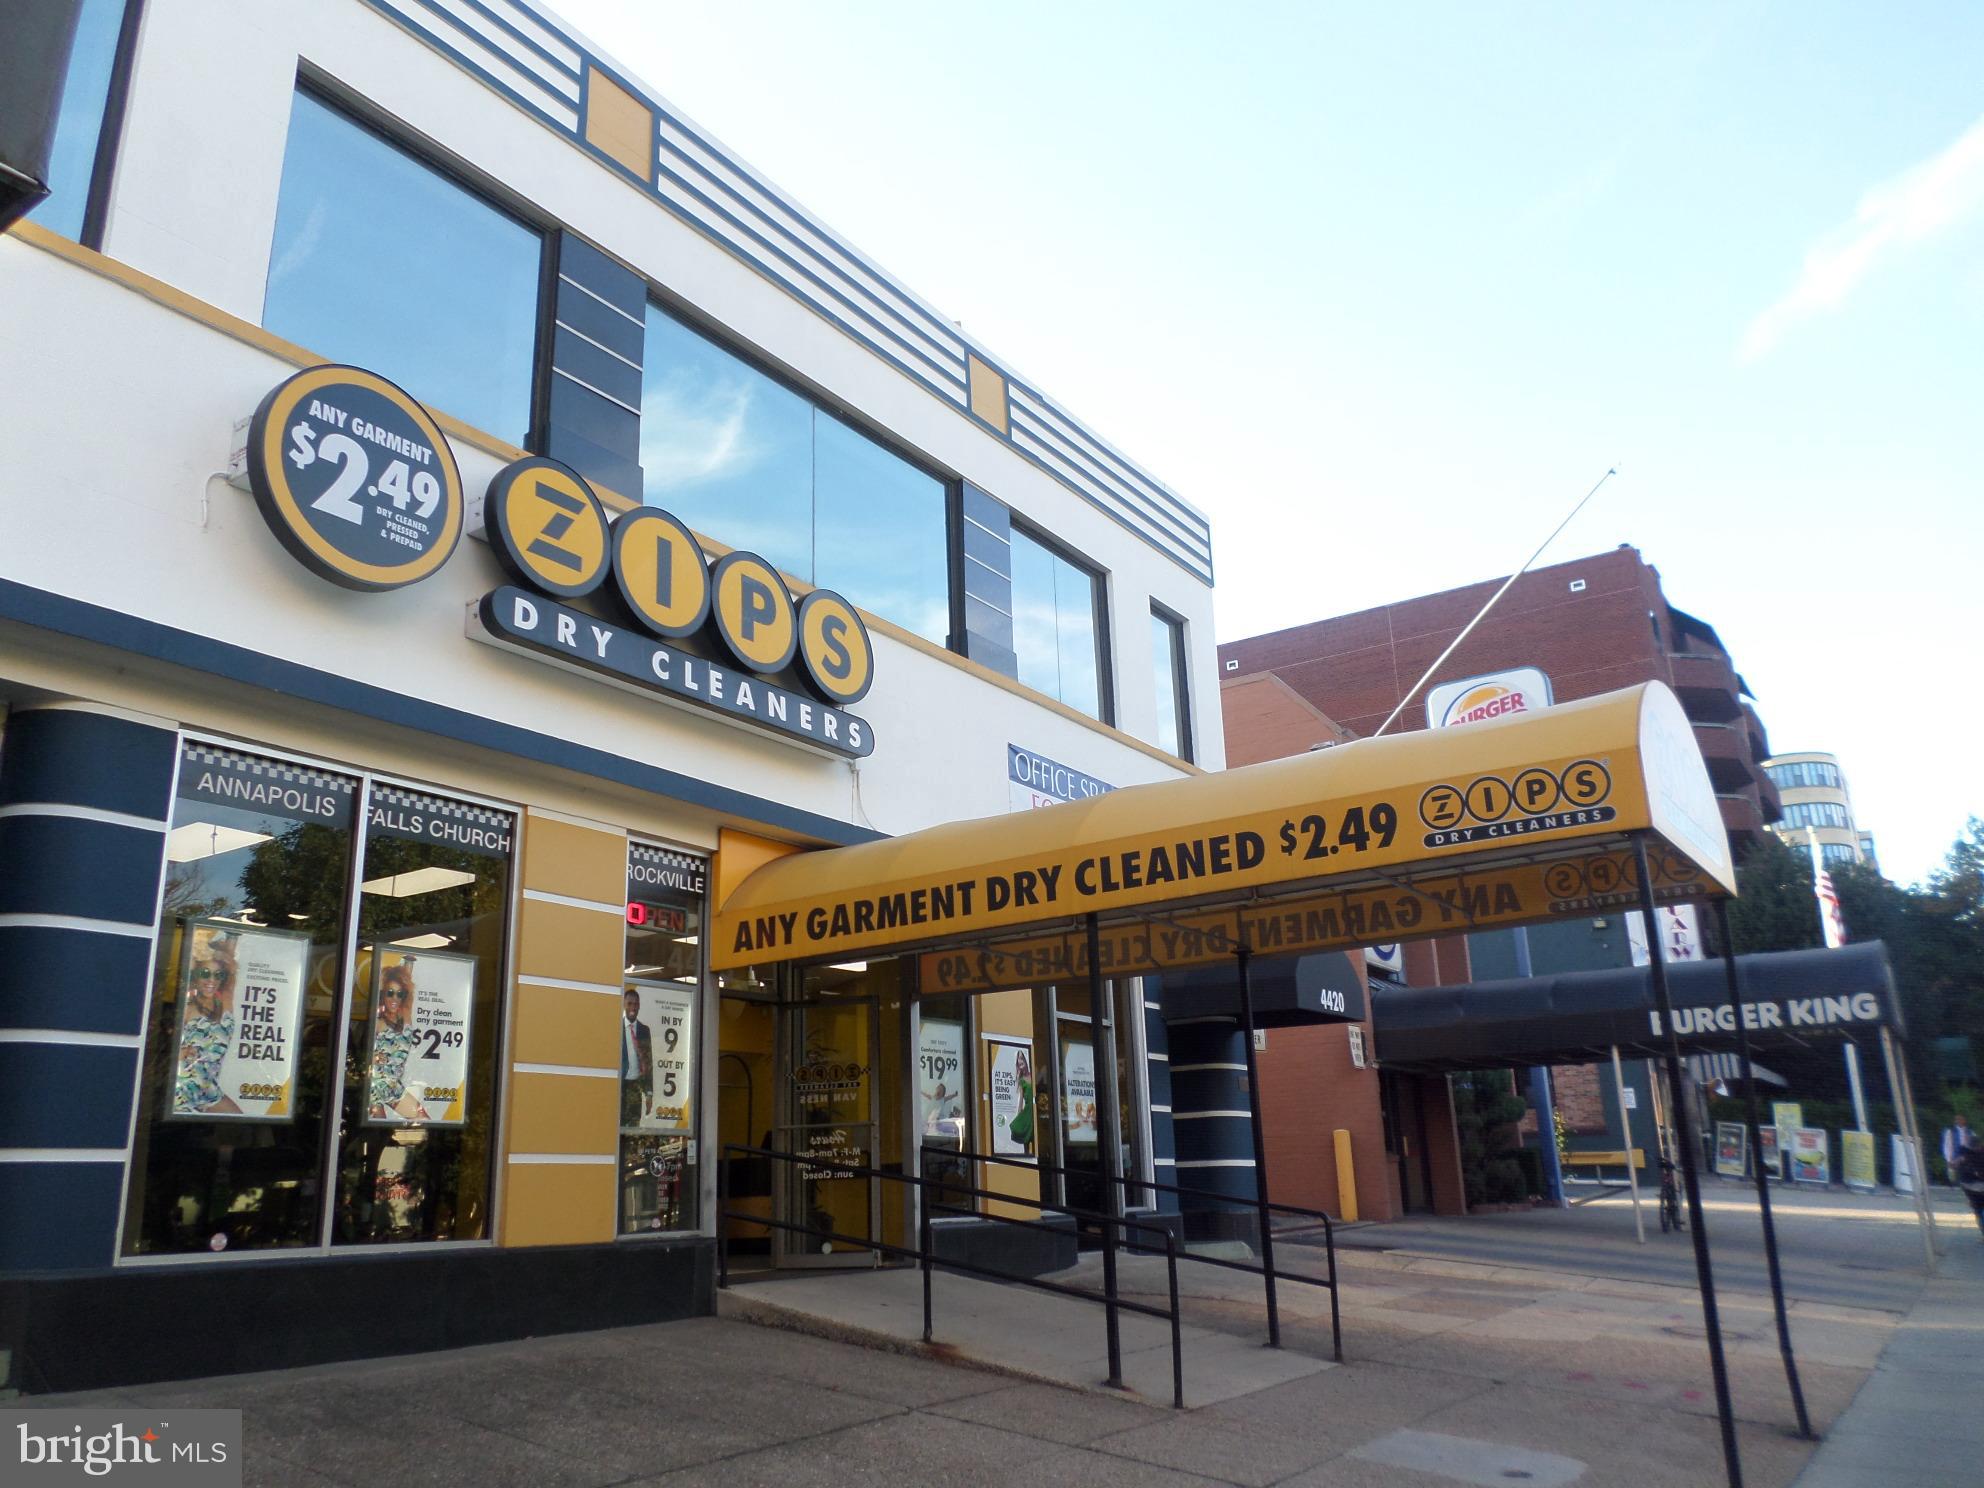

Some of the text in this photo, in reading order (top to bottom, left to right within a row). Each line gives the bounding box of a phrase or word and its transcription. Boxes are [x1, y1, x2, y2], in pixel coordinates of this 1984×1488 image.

[309, 400, 432, 465] ANY GARMENT
[288, 421, 440, 525] $2.49
[376, 506, 430, 535] DRY CLEANED,
[386, 521, 418, 539] PRESSED
[380, 529, 423, 551] & PREPAID
[525, 480, 852, 680] ZIPS
[513, 597, 862, 749] DRY CLEANERS
[1015, 752, 1077, 801] OFFICE
[197, 772, 336, 817] ANNAPOLIS
[1427, 767, 1602, 825] ZIPS
[428, 820, 512, 854] CHURCH
[1435, 810, 1602, 845] DRY CLEANERS
[628, 864, 704, 894] ROCKVILLE
[733, 802, 1398, 953] ANY GARMENT DRY CLEANED $2.49
[627, 902, 686, 934] OPEN
[244, 986, 277, 1004] IT'S
[1320, 989, 1345, 1013] 4420
[241, 1004, 274, 1023] THE
[416, 1017, 463, 1027] any garment
[417, 1007, 453, 1017] Dry clean
[661, 1016, 683, 1026] IN BY
[1789, 992, 1879, 1028] KING
[239, 1023, 286, 1043] REAL
[664, 1028, 678, 1053] 9
[238, 1043, 285, 1062] DEAL
[657, 1060, 685, 1070] OUT BY
[663, 1072, 677, 1097] 5
